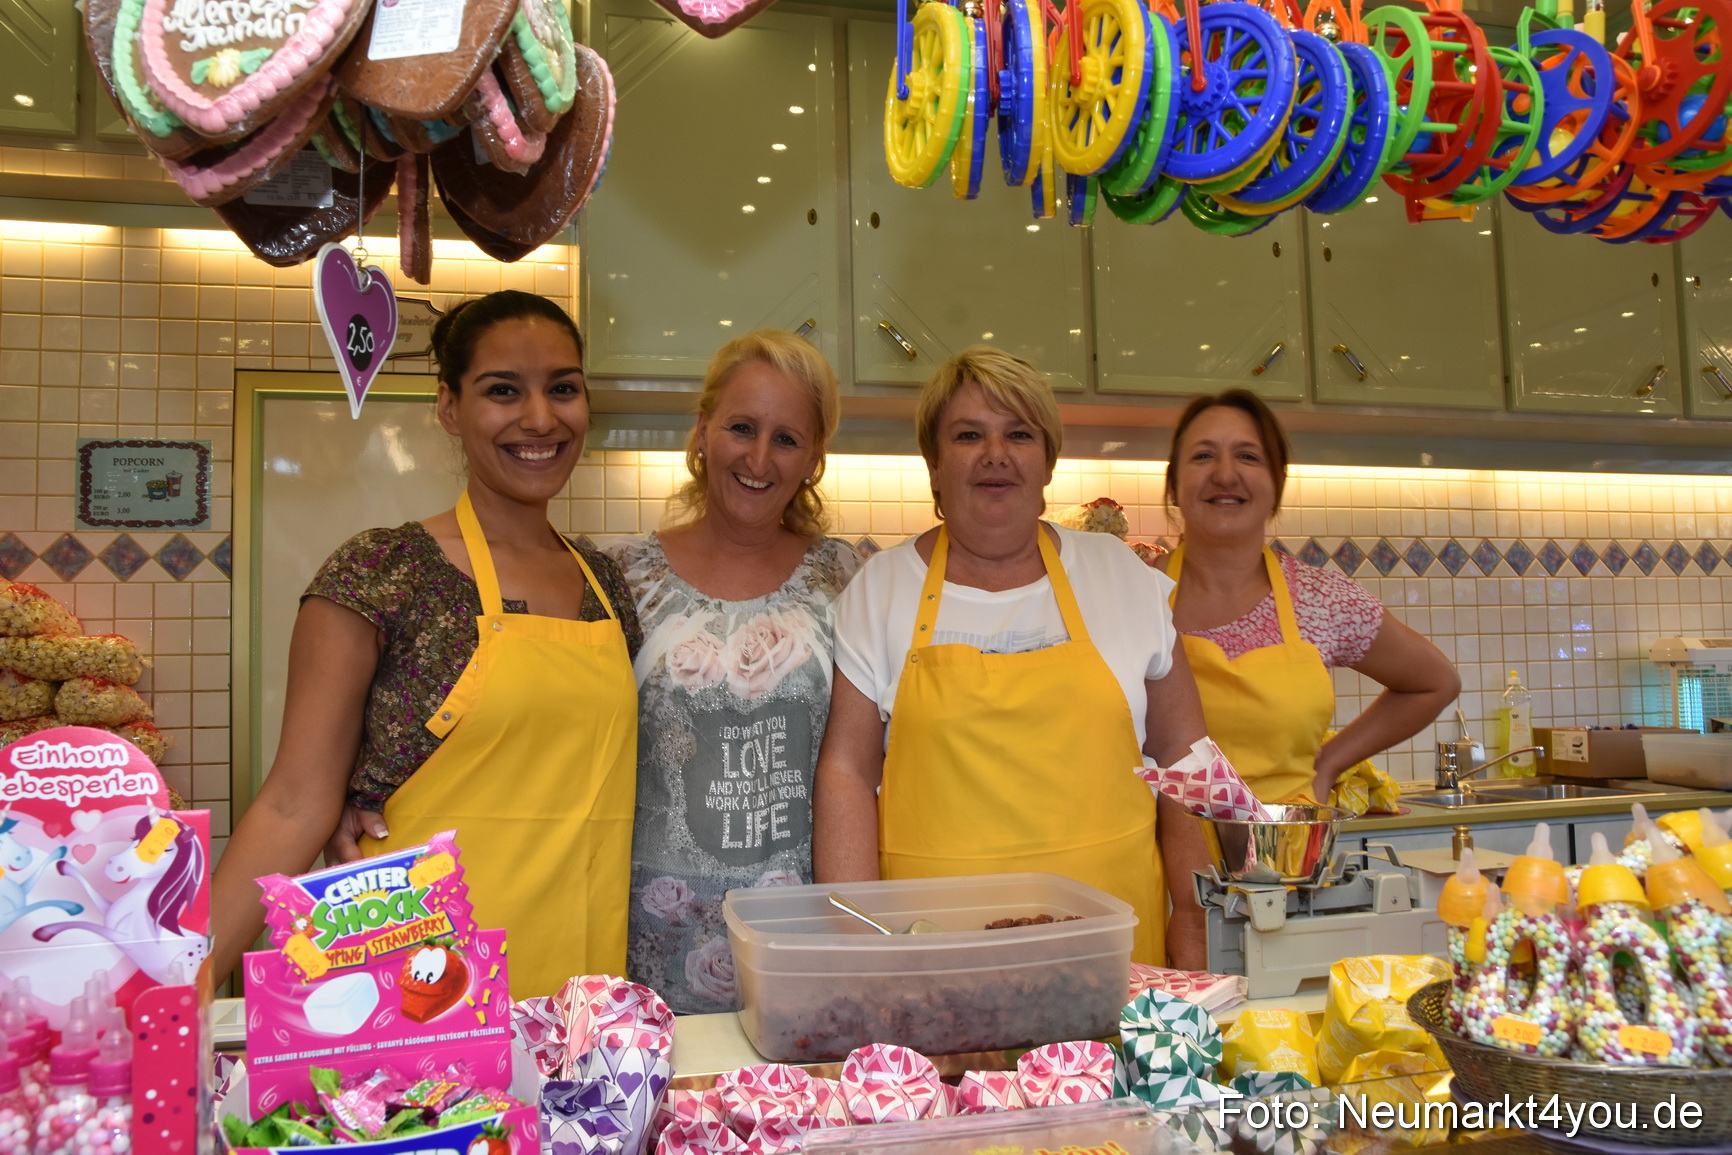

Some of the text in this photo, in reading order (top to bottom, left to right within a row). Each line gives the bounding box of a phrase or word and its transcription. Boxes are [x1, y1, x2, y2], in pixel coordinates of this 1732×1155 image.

[347, 322, 375, 356] 2,50
[356, 376, 362, 387] €
[113, 457, 165, 466] POPCORN
[766, 715, 786, 732] YOU
[17, 744, 124, 765] Einhorn
[722, 732, 787, 778] LOVE
[0, 772, 153, 802] ebesperlen
[709, 780, 733, 796] AND
[770, 769, 803, 787] NEVER
[705, 795, 739, 811] WORK
[742, 796, 750, 809] A
[752, 792, 768, 809] DAY
[777, 784, 808, 800] YOUR
[722, 802, 791, 849] LIFE
[325, 867, 408, 904] CENTER
[311, 886, 432, 949] SHOCK
[371, 916, 446, 956] STRAWBERRY
[254, 1056, 273, 1065] EXTRA
[275, 1053, 297, 1062] SAURER
[299, 1048, 333, 1059] KAUGUMMI
[334, 1046, 345, 1055] MIT
[346, 1043, 372, 1053] FÜLLUNG
